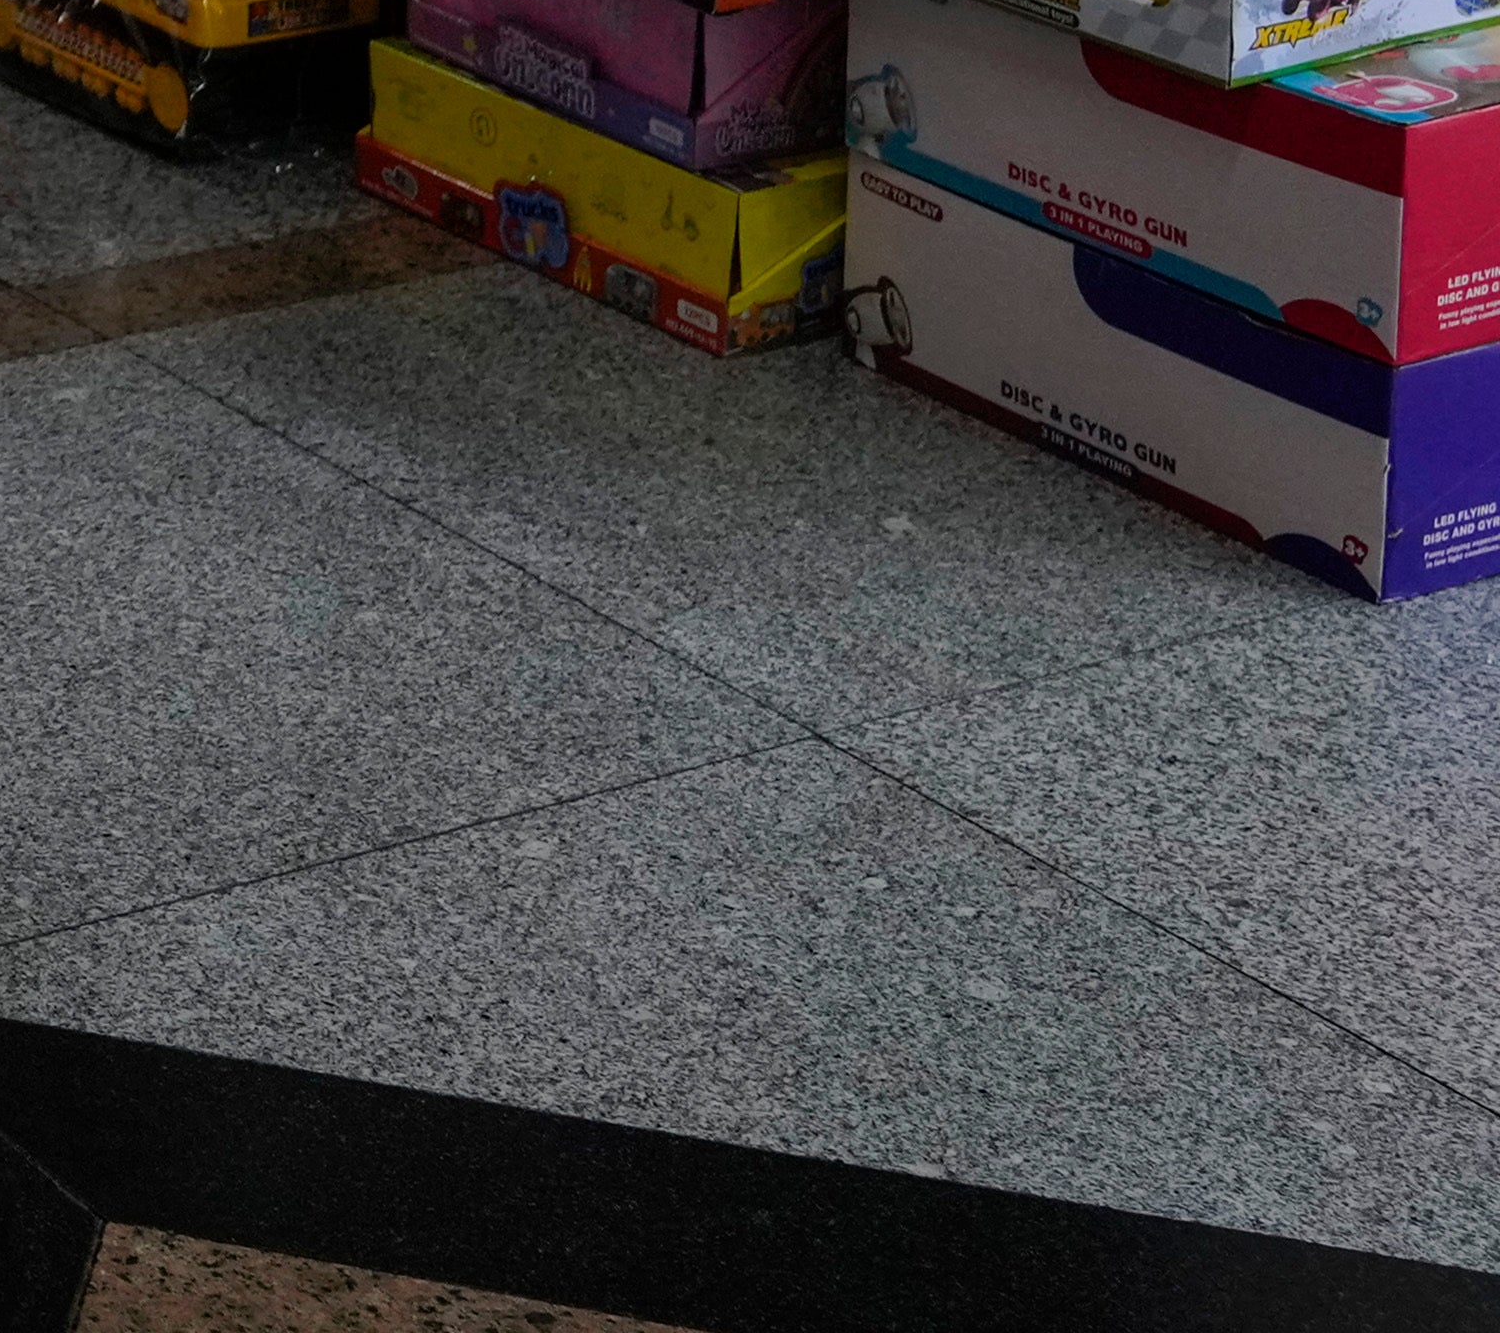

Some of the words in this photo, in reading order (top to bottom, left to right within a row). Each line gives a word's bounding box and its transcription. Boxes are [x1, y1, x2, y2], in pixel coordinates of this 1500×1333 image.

[506, 196, 560, 222] trucks
[894, 188, 908, 205] TO
[909, 194, 941, 220] PLAY
[1008, 162, 1051, 194] DISC
[1058, 183, 1072, 202] &
[1078, 191, 1138, 228] GYRO
[1144, 217, 1189, 249] GUN
[1060, 208, 1076, 227] IN
[1086, 220, 1146, 255] PLAYING
[1447, 273, 1470, 291] LED
[1436, 288, 1465, 308] DISC
[1466, 283, 1489, 302] AND
[1360, 299, 1381, 322] 3+
[1001, 379, 1044, 414] DISC
[1049, 404, 1063, 423] &
[1069, 412, 1128, 452] GYRO
[1134, 441, 1177, 476] GUN
[1051, 429, 1066, 444] IN
[1076, 440, 1134, 479] PLAYING
[1433, 511, 1457, 529] LED
[1457, 501, 1497, 522] FLYING
[1343, 535, 1367, 558] 3+
[1422, 527, 1450, 547] DISC
[1451, 521, 1475, 540] AND
[1423, 548, 1445, 563] Funny
[1446, 542, 1471, 558] playing
[1434, 555, 1447, 568] low
[1448, 550, 1465, 565] light
